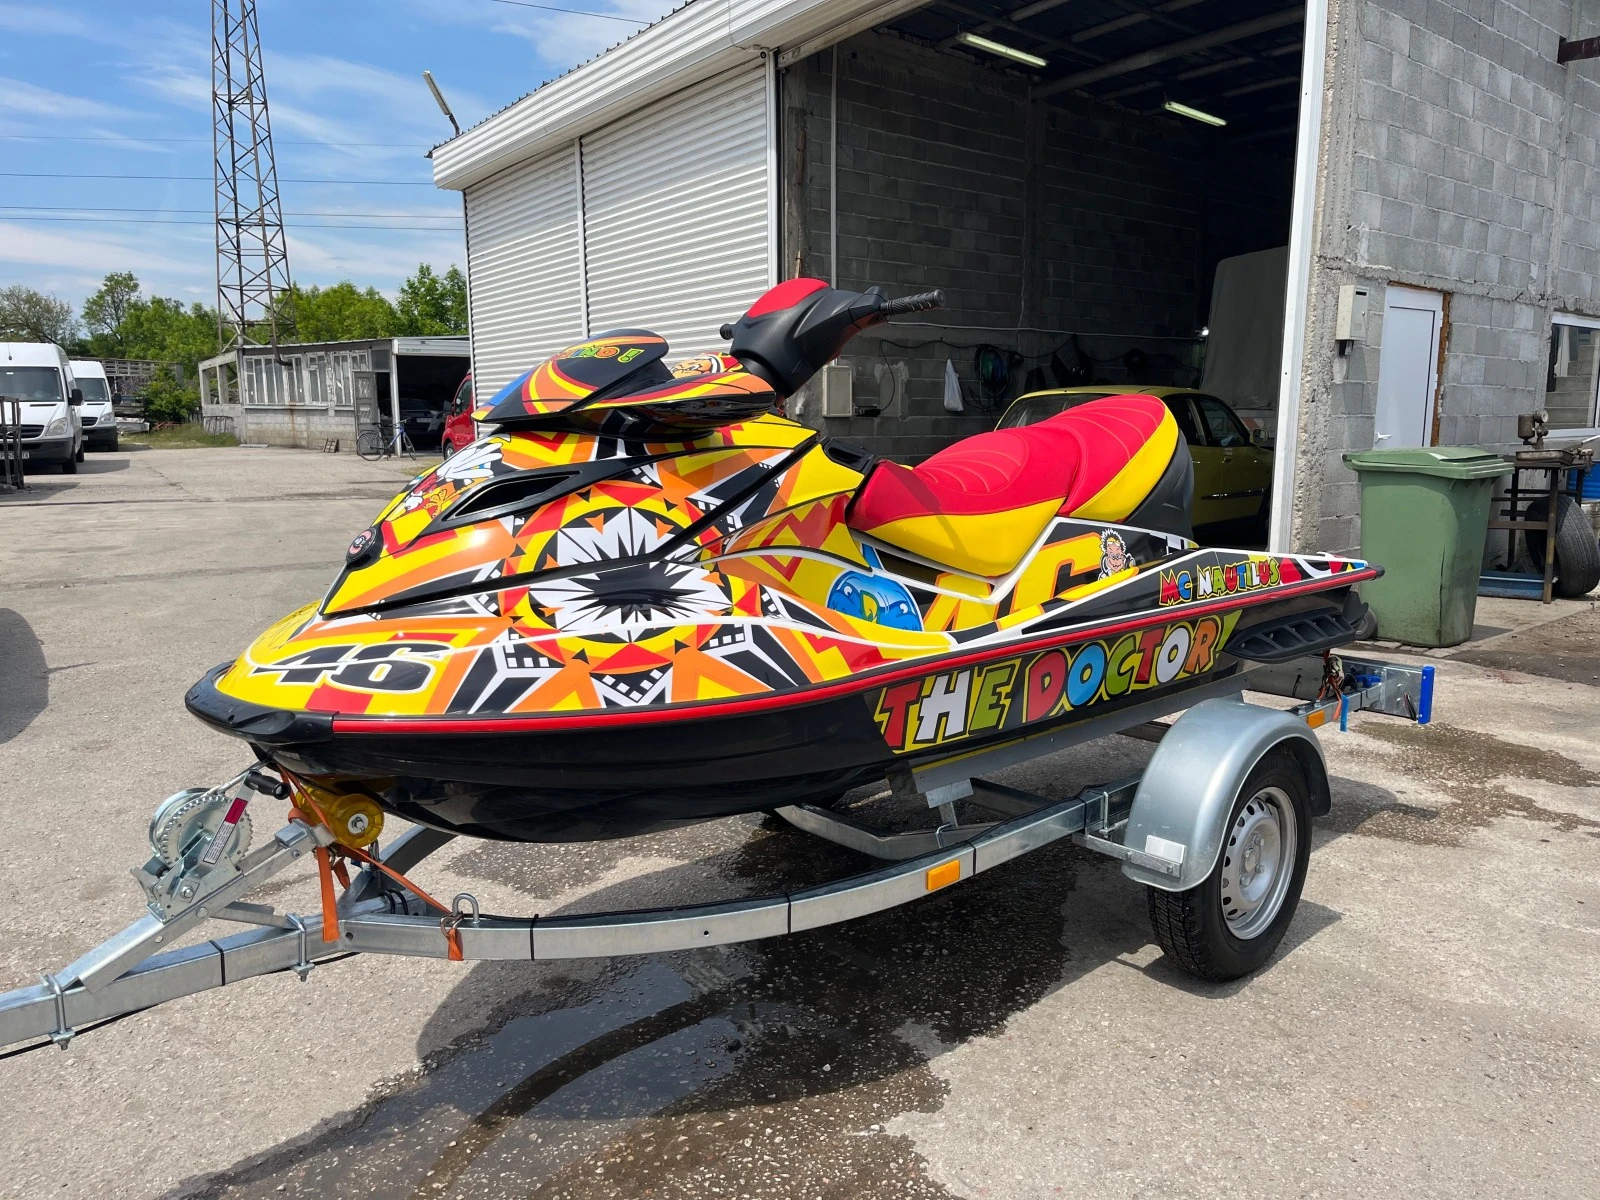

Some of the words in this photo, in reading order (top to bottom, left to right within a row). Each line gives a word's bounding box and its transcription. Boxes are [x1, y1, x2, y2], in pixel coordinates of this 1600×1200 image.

[1159, 569, 1193, 606] MC
[1196, 556, 1280, 599] NAUTILUS
[249, 641, 454, 694] 46
[874, 658, 1022, 754] THE
